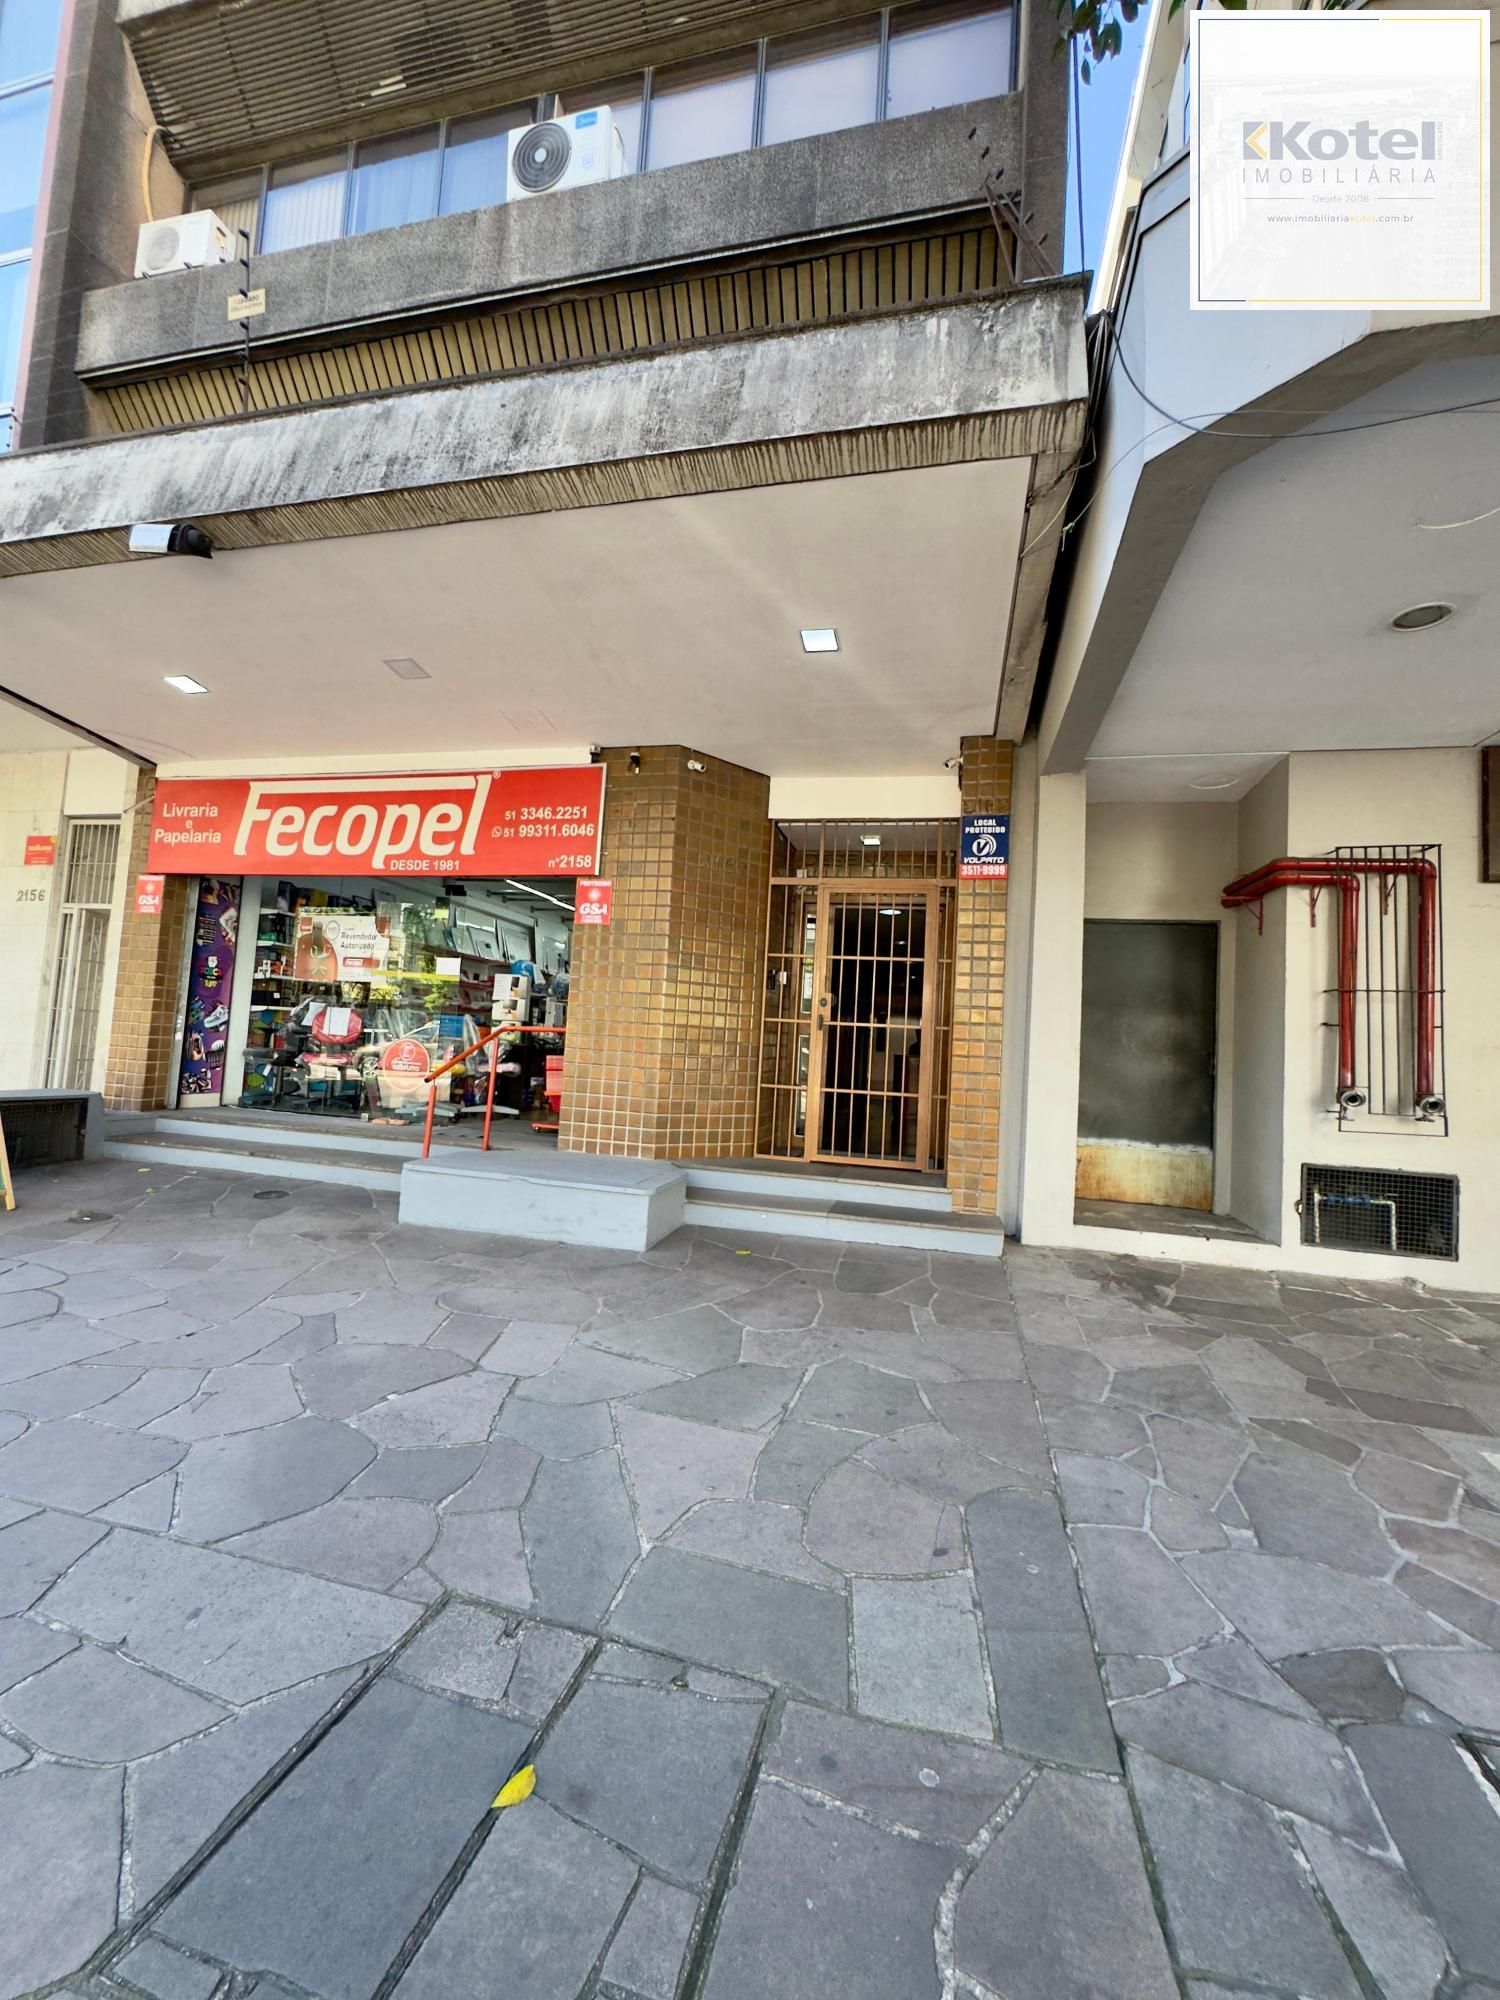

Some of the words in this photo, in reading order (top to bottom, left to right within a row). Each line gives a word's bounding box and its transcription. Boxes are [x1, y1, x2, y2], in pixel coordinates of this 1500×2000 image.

[162, 803, 219, 817] Livraria
[504, 811, 516, 820] 51
[520, 806, 588, 820] 3346.2251
[185, 820, 193, 829] e
[233, 774, 493, 870] Fecopel
[503, 828, 515, 837] 51
[518, 824, 595, 837] 99311.6046
[964, 826, 1006, 834] PROTEGIDO
[154, 829, 222, 847] Papelaria
[390, 860, 431, 871] DESDE
[433, 859, 461, 871] 1981
[961, 865, 1006, 876] 3511-9999
[16, 889, 46, 903] 2156
